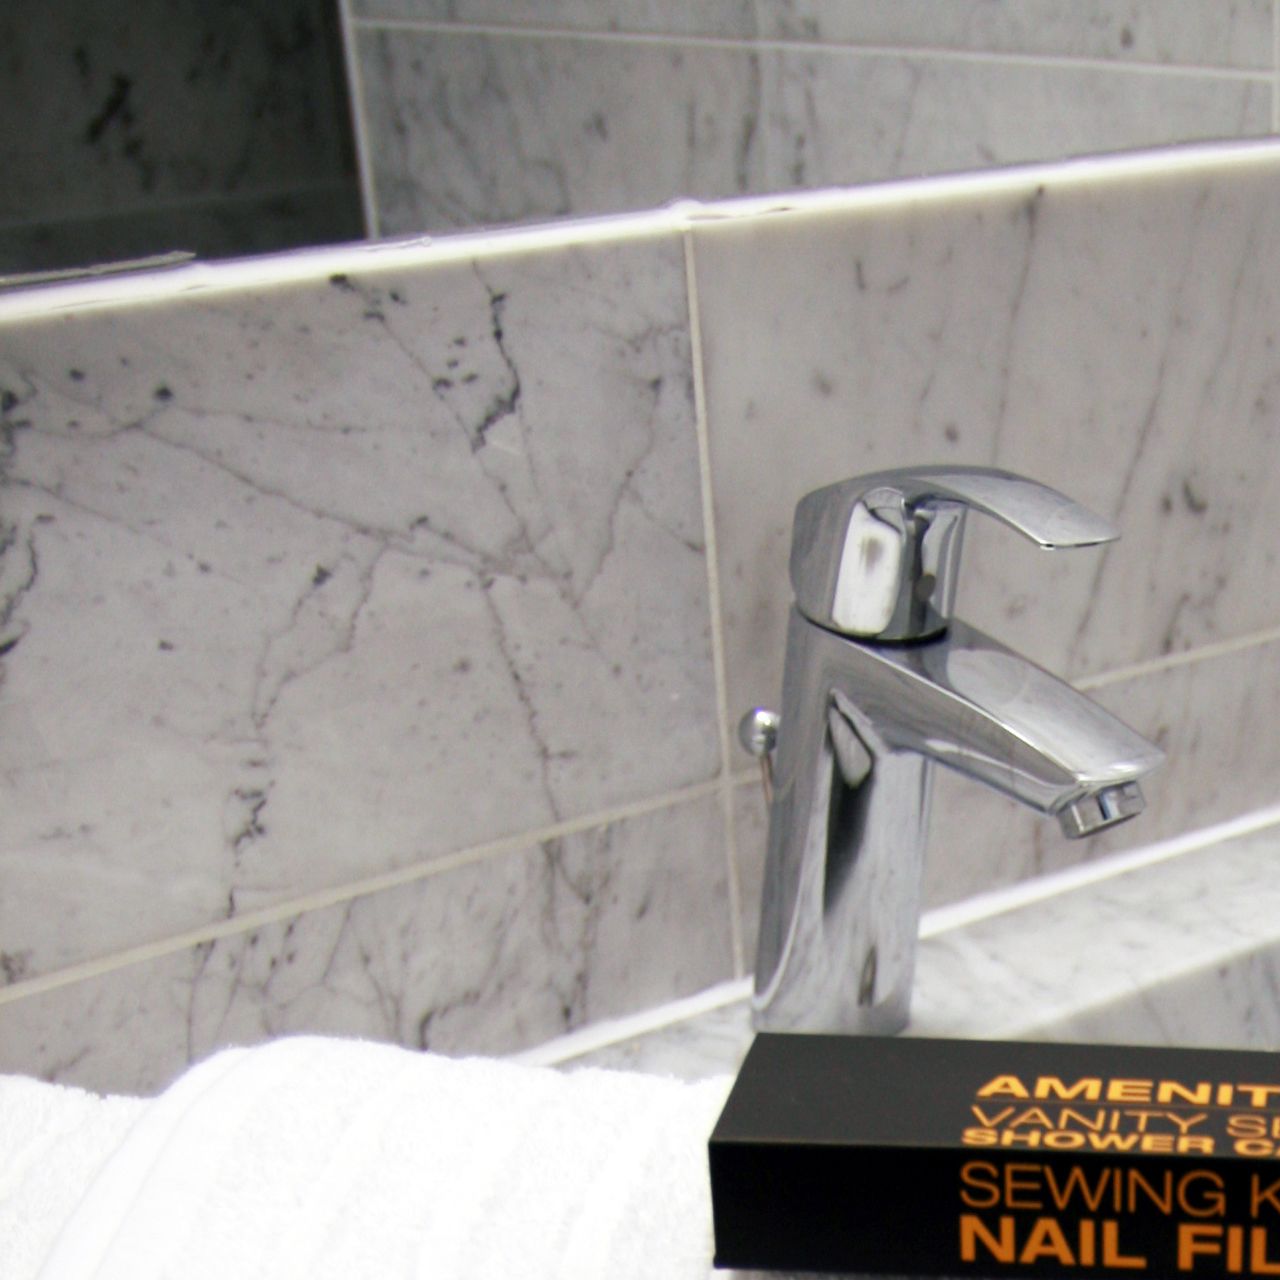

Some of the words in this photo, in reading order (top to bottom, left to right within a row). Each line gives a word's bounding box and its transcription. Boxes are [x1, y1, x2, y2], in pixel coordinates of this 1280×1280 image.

[961, 1127, 1214, 1153] SHOWER
[971, 1105, 1207, 1134] VANITY
[959, 1161, 1226, 1217] SEWING
[959, 1215, 1147, 1269] NAIL
